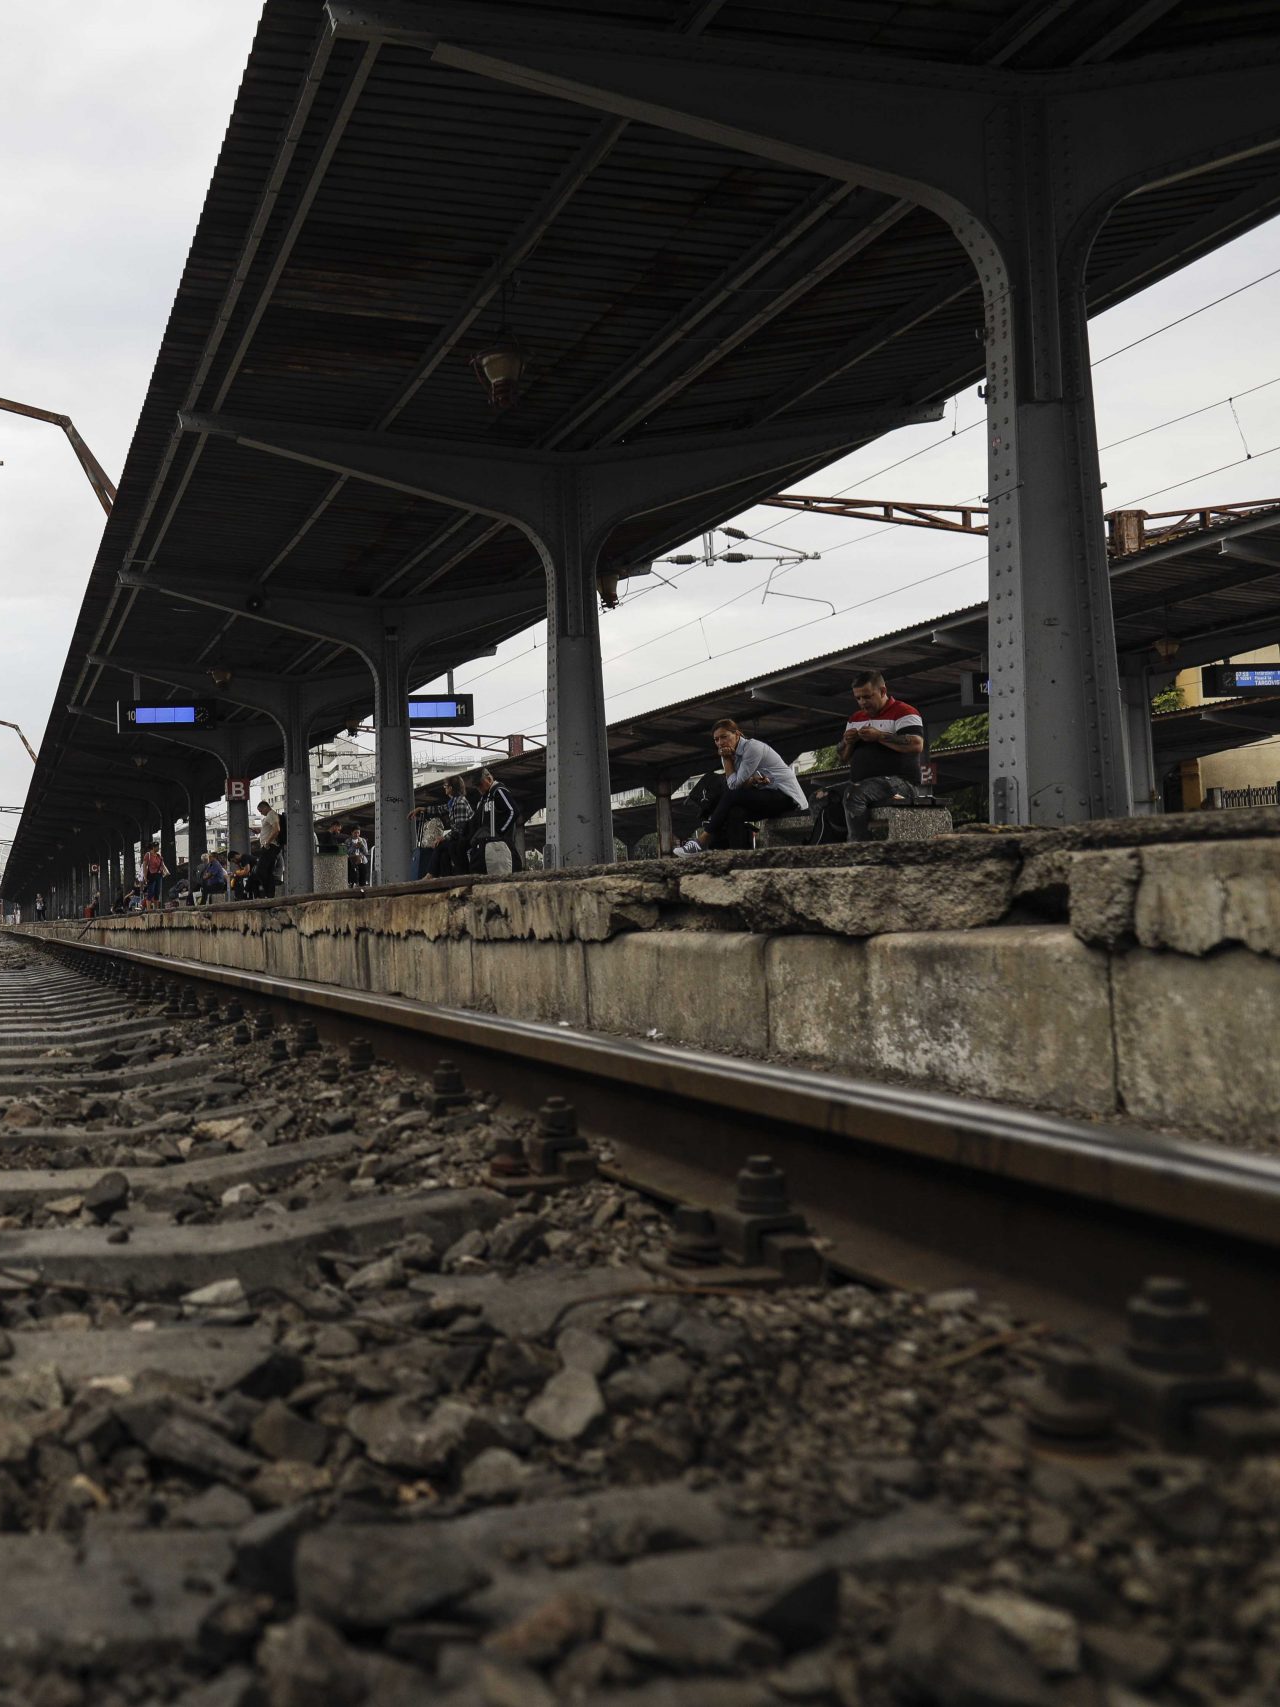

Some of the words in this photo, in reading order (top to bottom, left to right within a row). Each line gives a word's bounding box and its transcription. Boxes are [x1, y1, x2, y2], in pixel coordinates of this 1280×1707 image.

[980, 683, 988, 693] 12
[456, 704, 465, 715] 11
[127, 710, 136, 721] 10
[231, 781, 245, 797] B
[91, 864, 98, 872] C
